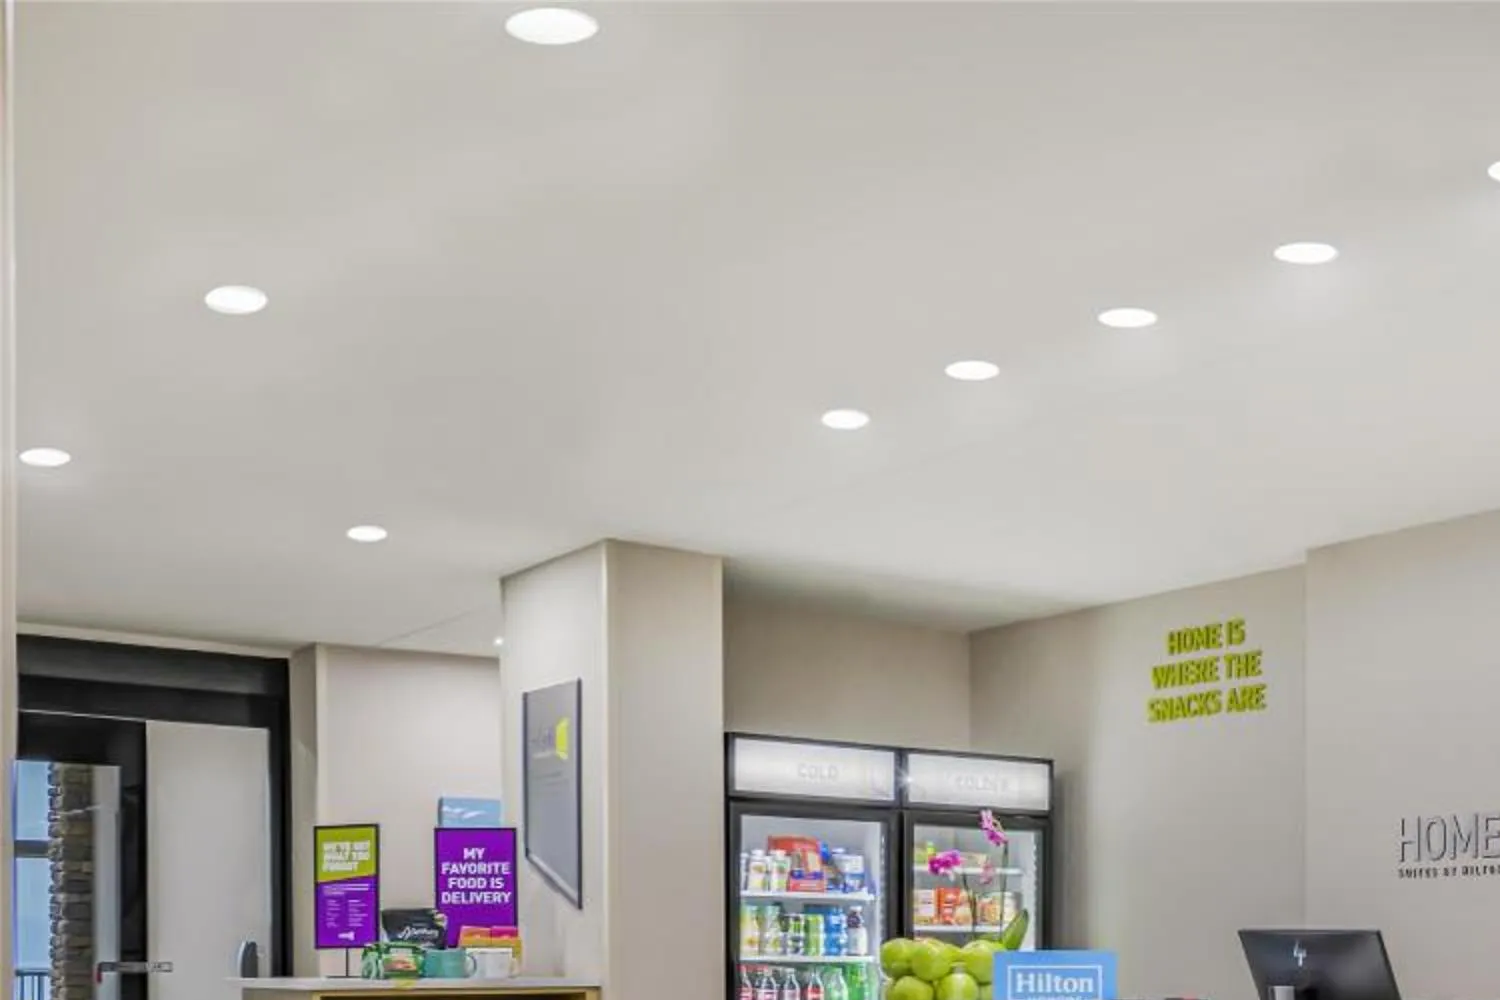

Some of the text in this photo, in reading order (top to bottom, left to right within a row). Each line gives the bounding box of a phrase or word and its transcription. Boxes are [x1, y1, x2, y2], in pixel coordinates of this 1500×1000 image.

[1167, 618, 1246, 656] HOME IS
[1151, 649, 1263, 690] WHERE THE
[1147, 683, 1267, 723] SNACKS ARE
[797, 763, 839, 780] COLD
[463, 848, 485, 860] MY
[441, 862, 511, 875] FAVORITE
[447, 877, 504, 889] FOOD IS
[441, 891, 512, 905] DELIVERY
[1016, 973, 1094, 993] Hilton
